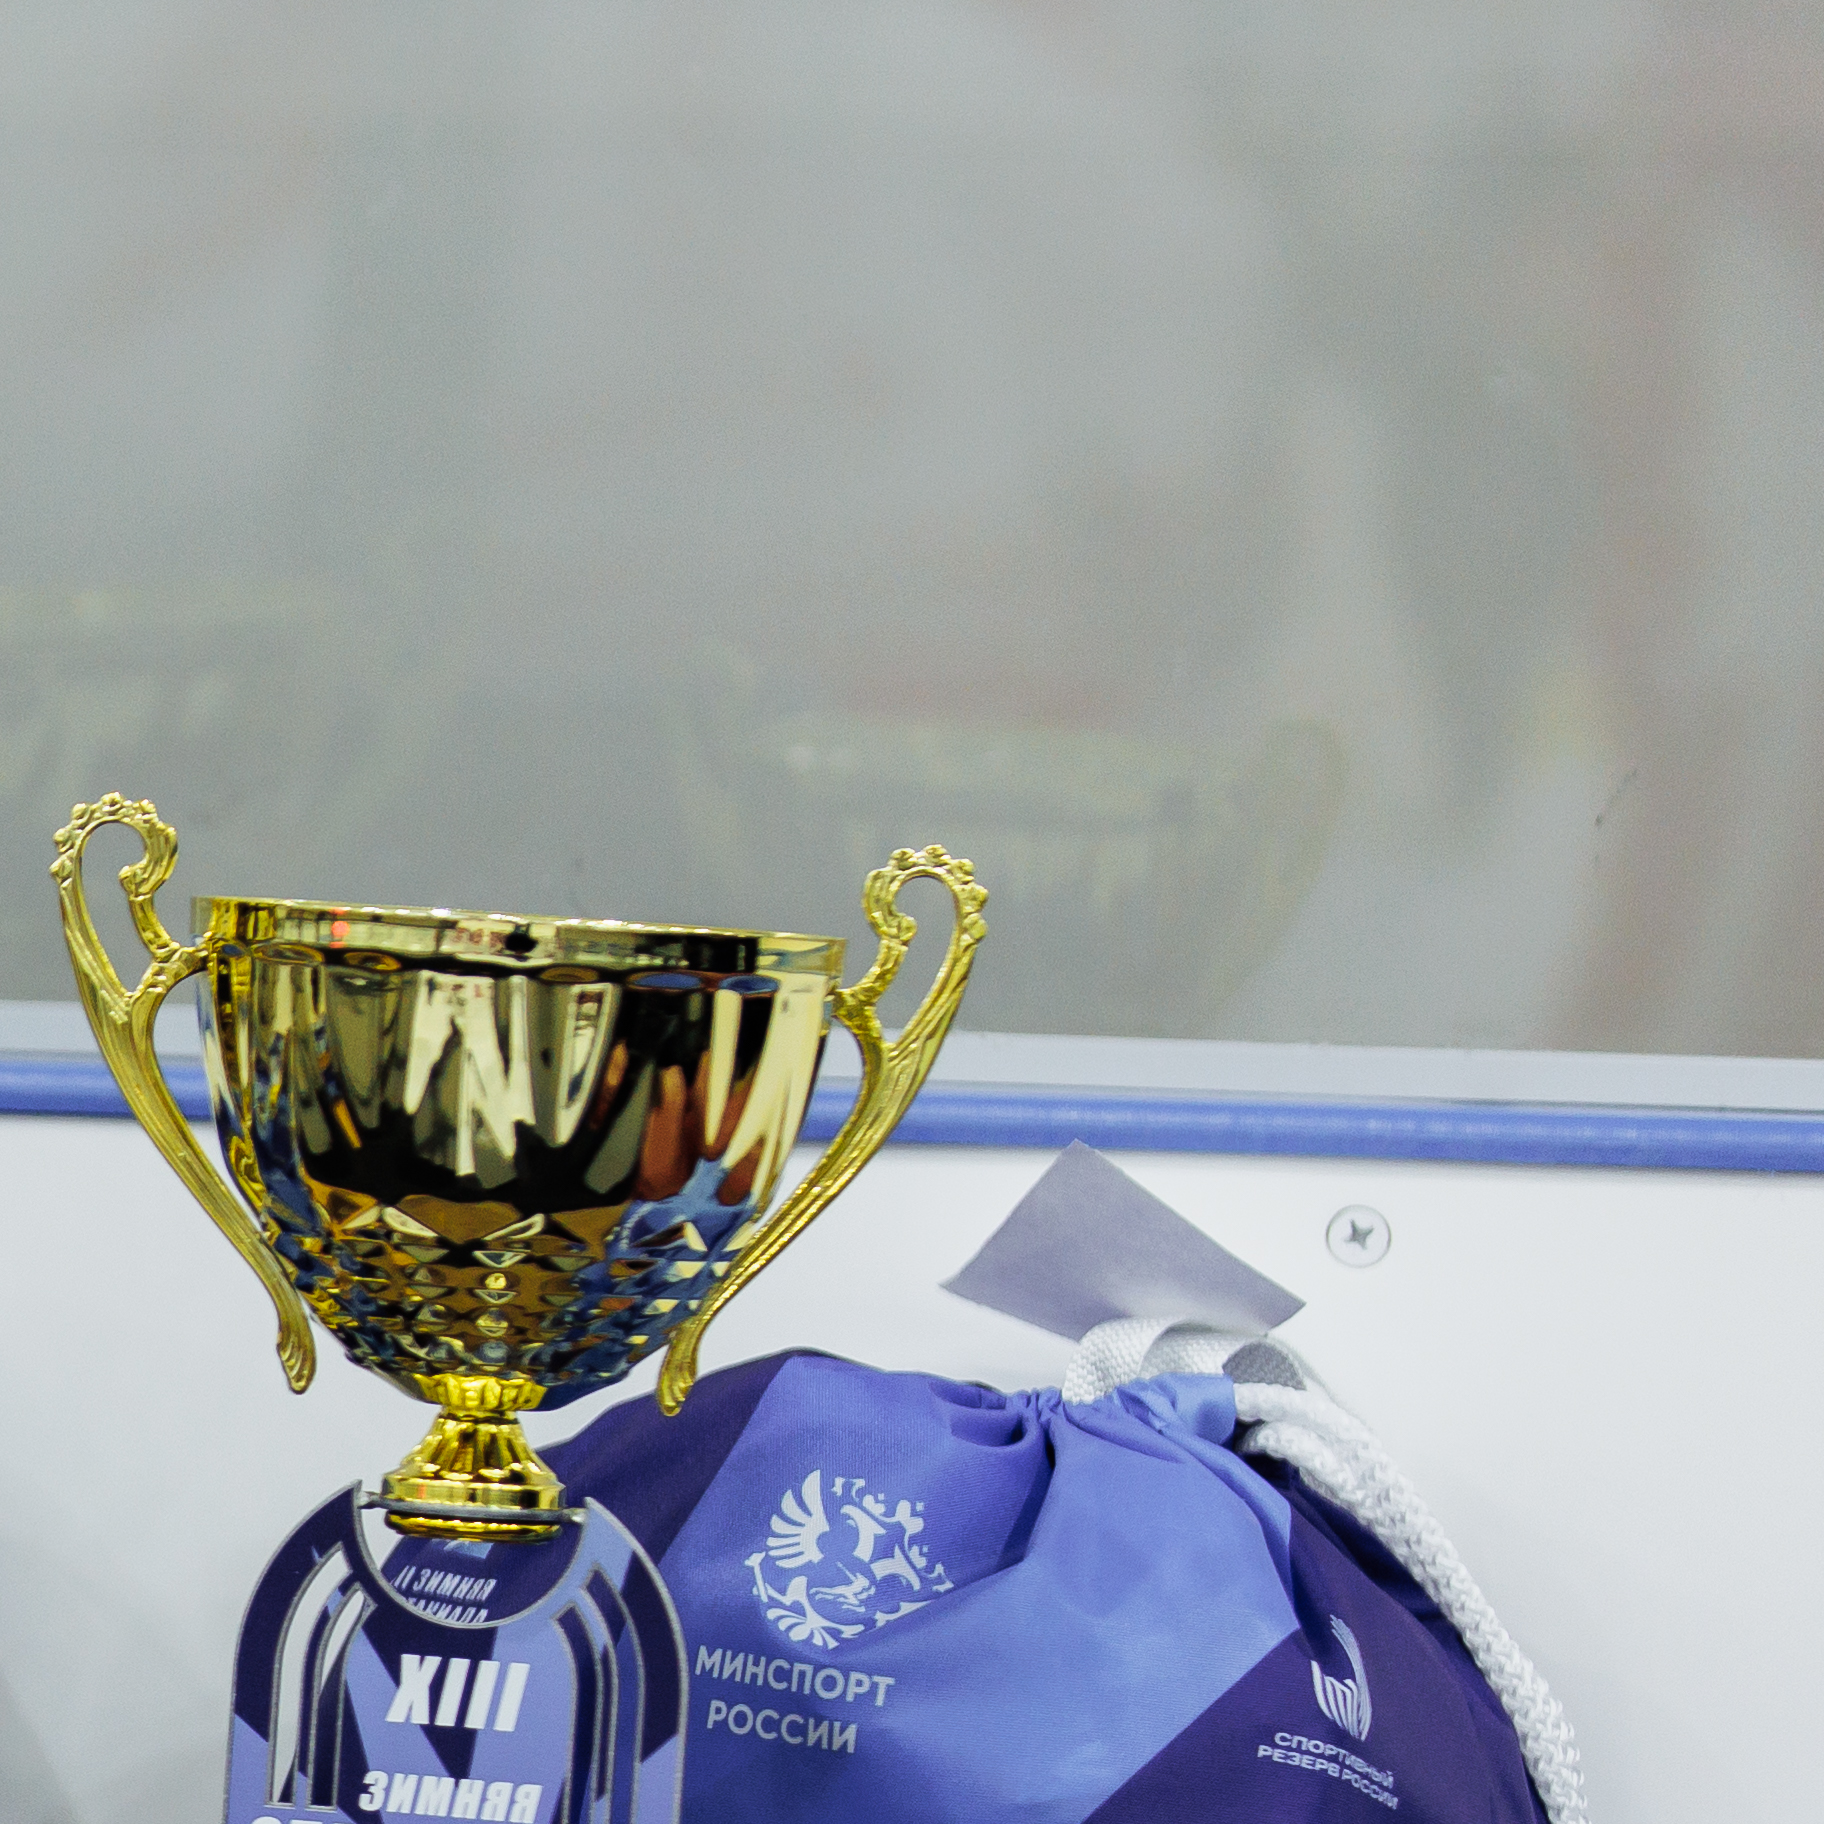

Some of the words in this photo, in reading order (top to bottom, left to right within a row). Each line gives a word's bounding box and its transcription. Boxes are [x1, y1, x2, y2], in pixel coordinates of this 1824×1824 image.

[413, 1568, 497, 1601] ЗИМНЯЯ
[385, 1653, 531, 1732] XIII
[694, 1645, 895, 1706] МИНСПОРТ
[706, 1700, 858, 1754] РОССИИ
[1257, 1744, 1341, 1778] РЕЗЕРВ
[358, 1770, 542, 1824] ЗИМНЯЯ
